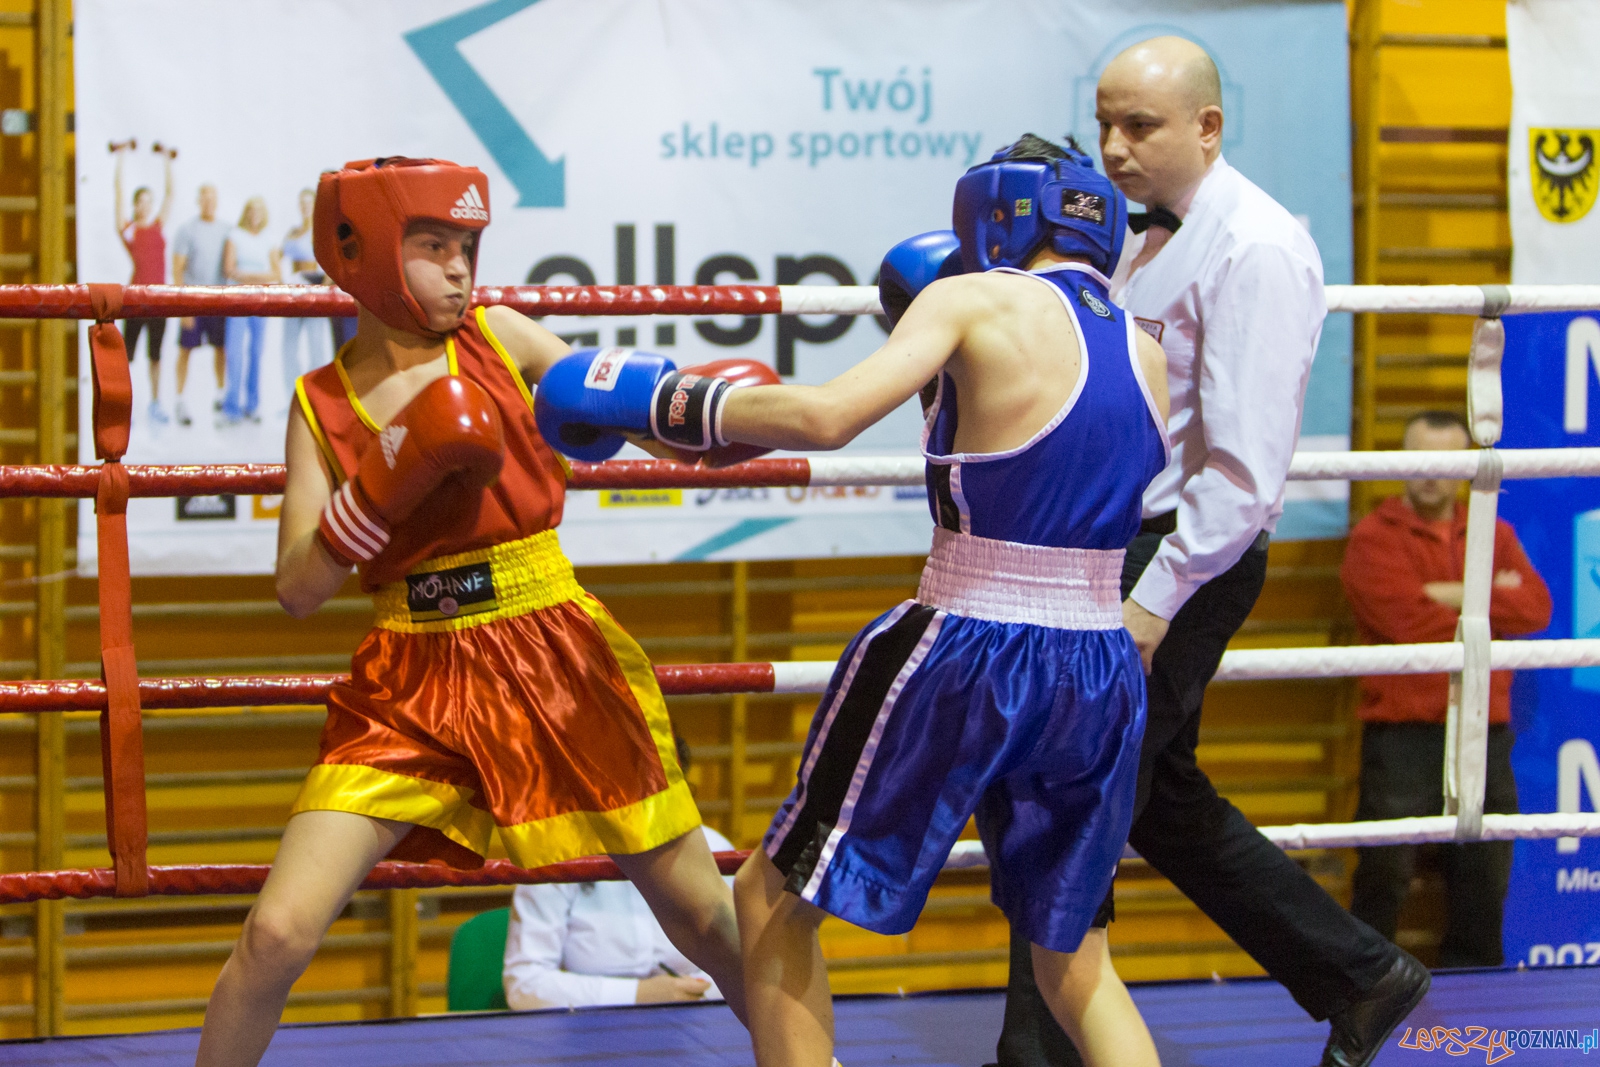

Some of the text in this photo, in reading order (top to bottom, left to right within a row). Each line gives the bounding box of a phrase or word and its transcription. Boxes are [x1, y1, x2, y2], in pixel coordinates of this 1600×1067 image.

[812, 66, 933, 124] Twój
[660, 121, 982, 168] sklep sportowy
[669, 388, 691, 428] TOP
